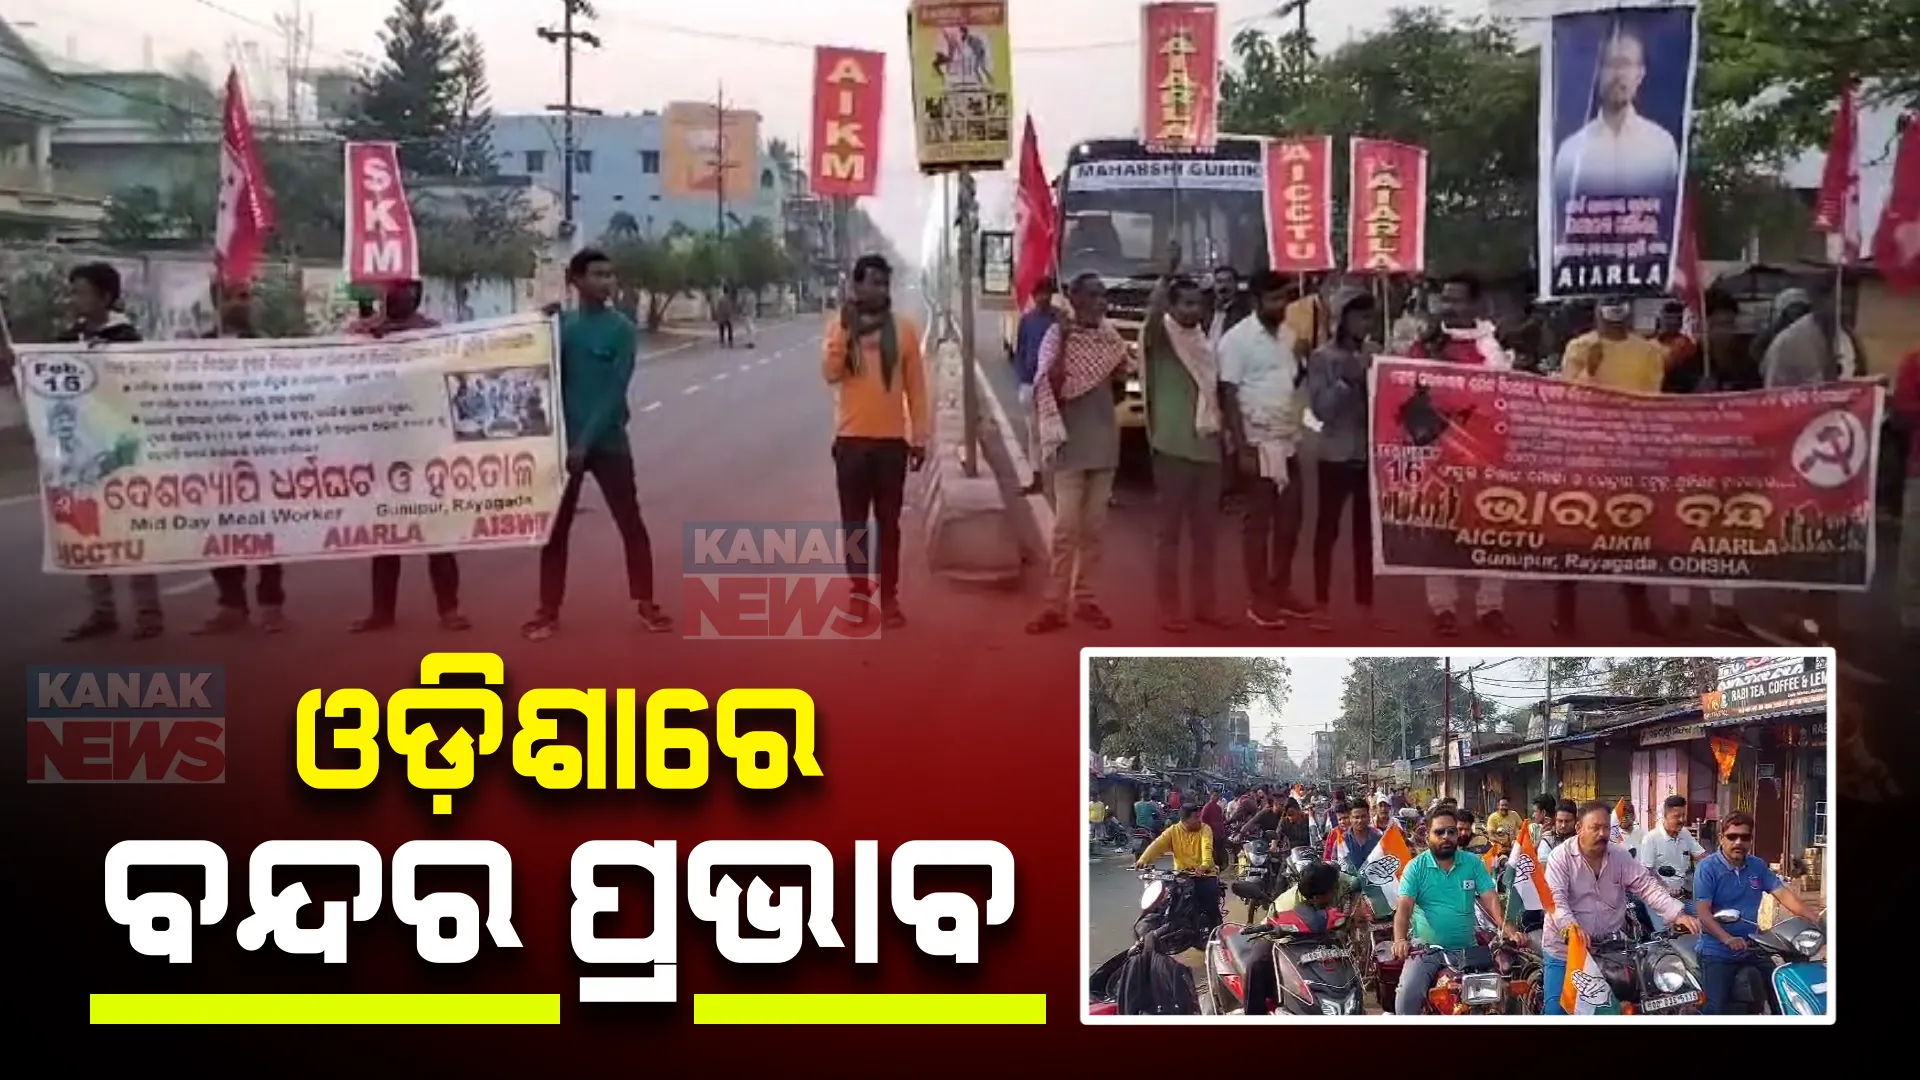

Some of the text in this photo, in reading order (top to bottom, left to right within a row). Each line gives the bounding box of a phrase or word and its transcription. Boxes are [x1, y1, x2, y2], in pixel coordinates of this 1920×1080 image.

[821, 57, 869, 181] AIKM
[362, 157, 402, 274] SKM
[1281, 144, 1317, 260] AICCTU
[1364, 172, 1404, 270] AIARLA
[1557, 263, 1661, 288] AIARLA
[35, 362, 85, 376] Feb.
[387, 460, 415, 494] ଓ
[1387, 459, 1424, 484] 16
[130, 507, 343, 532] Mid Day Meal Worker
[1475, 486, 1654, 530] ଭାରତ
[202, 534, 275, 557] AIKM
[323, 523, 426, 549] AIARLA
[1456, 528, 1780, 556] AICCTU AIKM AIARLA
[1669, 556, 1751, 575] ODISHA
[1731, 687, 1749, 702] RABI
[1751, 684, 1767, 699] TEA,
[1768, 676, 1800, 694] COFFEE
[1801, 676, 1810, 688] &
